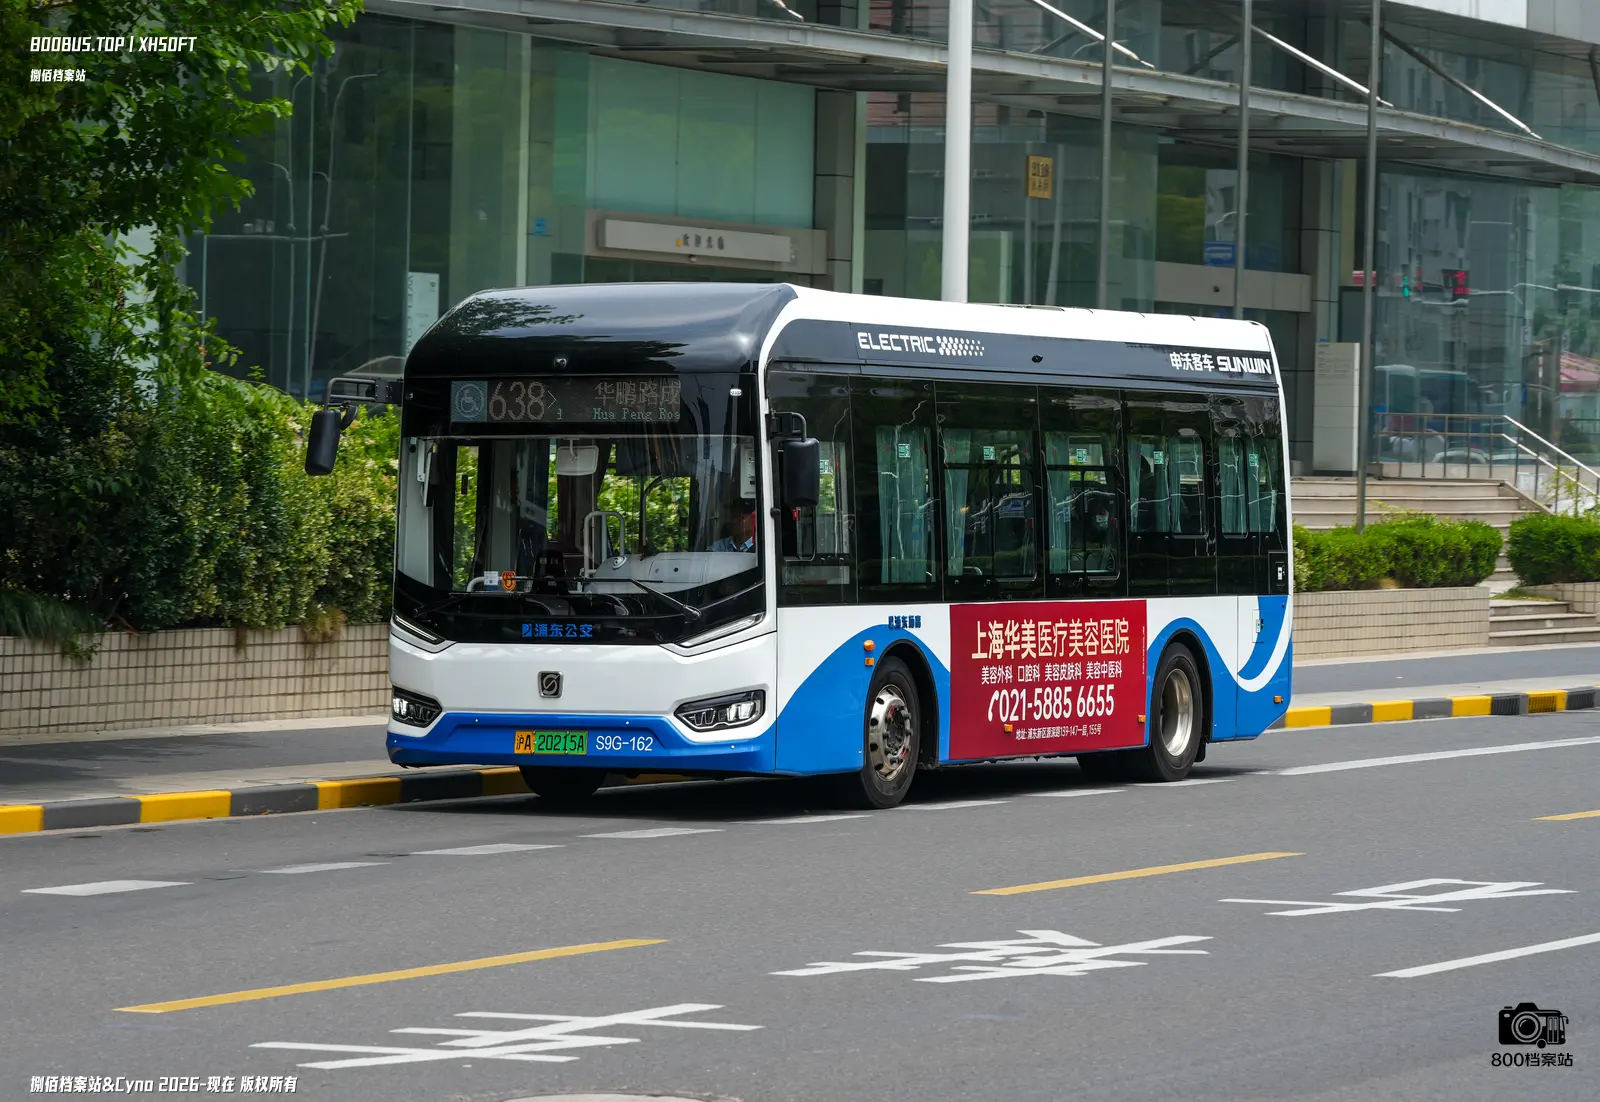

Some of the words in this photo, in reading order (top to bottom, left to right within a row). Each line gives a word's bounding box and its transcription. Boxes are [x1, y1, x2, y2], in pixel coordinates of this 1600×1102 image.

[857, 331, 937, 354] ELECTRIC
[1169, 351, 1215, 372] 申沃客车
[1216, 355, 1272, 375] SUNWIN
[489, 381, 546, 421] 638
[592, 407, 616, 420] Hua
[622, 407, 653, 421] Peng
[534, 623, 593, 638] 浦东公交
[971, 617, 1130, 660] 上海华美医疗美容医院
[981, 664, 1013, 685] 美容外科
[1017, 663, 1041, 683] 口腔科
[1044, 662, 1083, 682] 美容皮肤科
[1086, 660, 1123, 680] 美容中医科
[999, 686, 1073, 723] 021-5885
[1076, 683, 1115, 718] 6655
[595, 735, 654, 751] S9G-162
